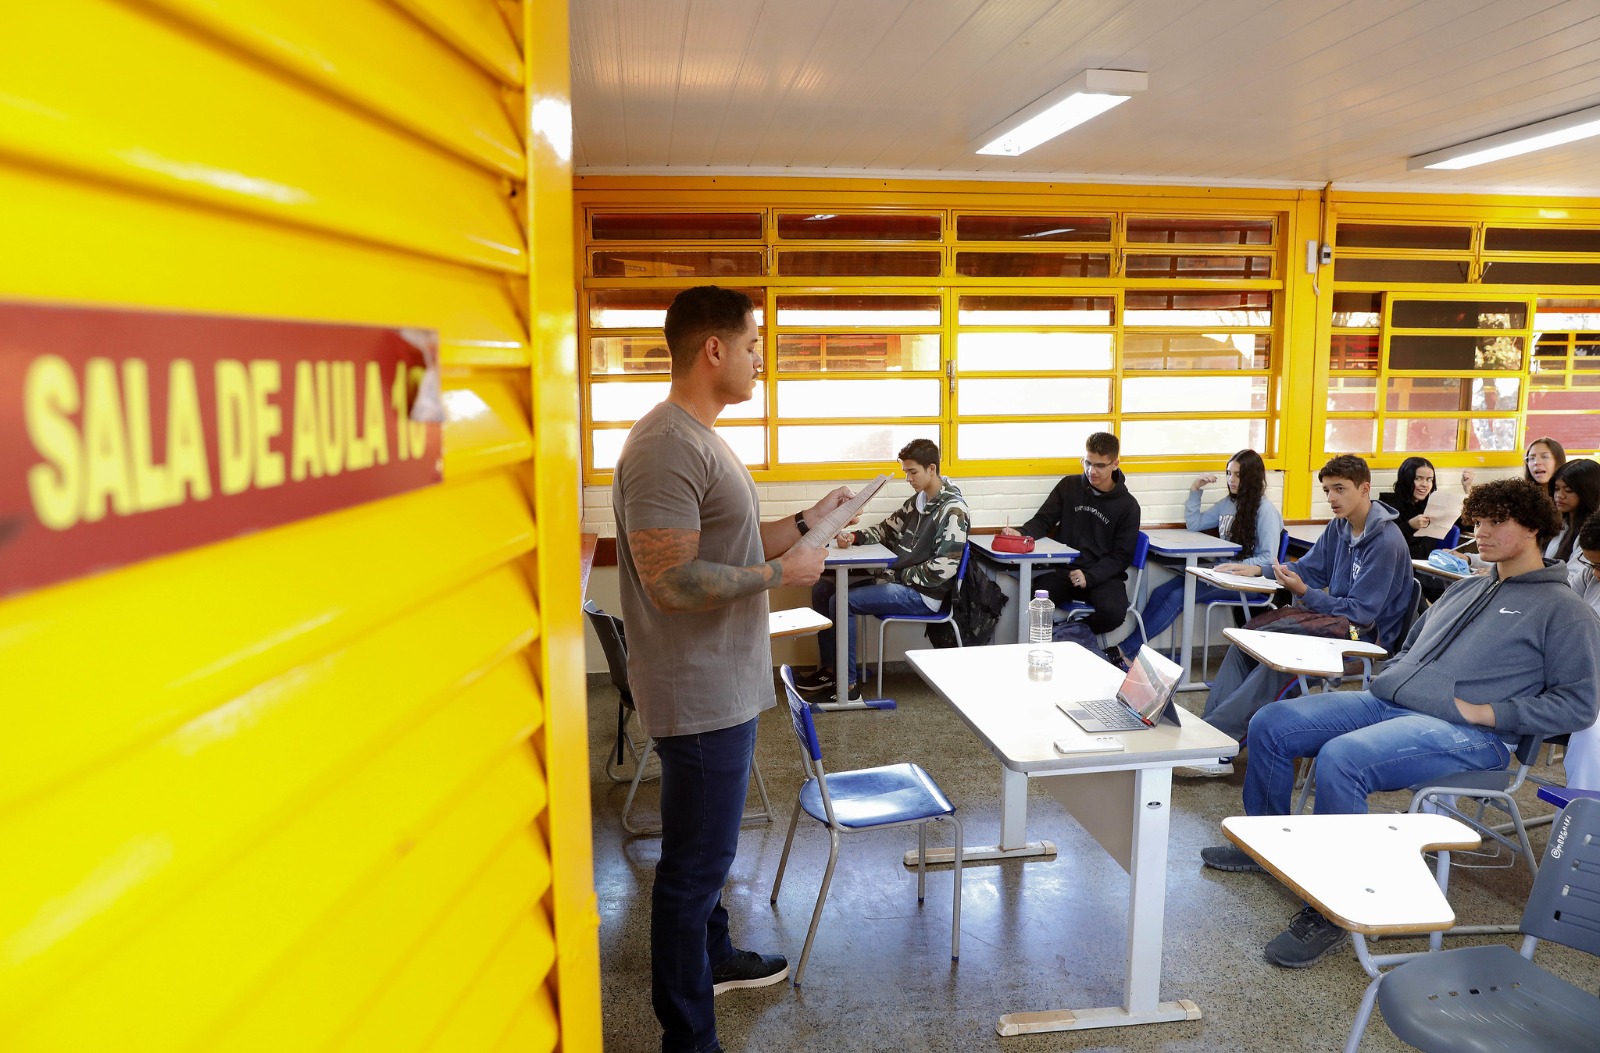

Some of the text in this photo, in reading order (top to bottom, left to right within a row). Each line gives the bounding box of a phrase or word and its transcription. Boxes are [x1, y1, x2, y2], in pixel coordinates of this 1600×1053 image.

[24, 354, 212, 531] SALA
[214, 359, 285, 495] DE
[292, 360, 389, 481] AULA
